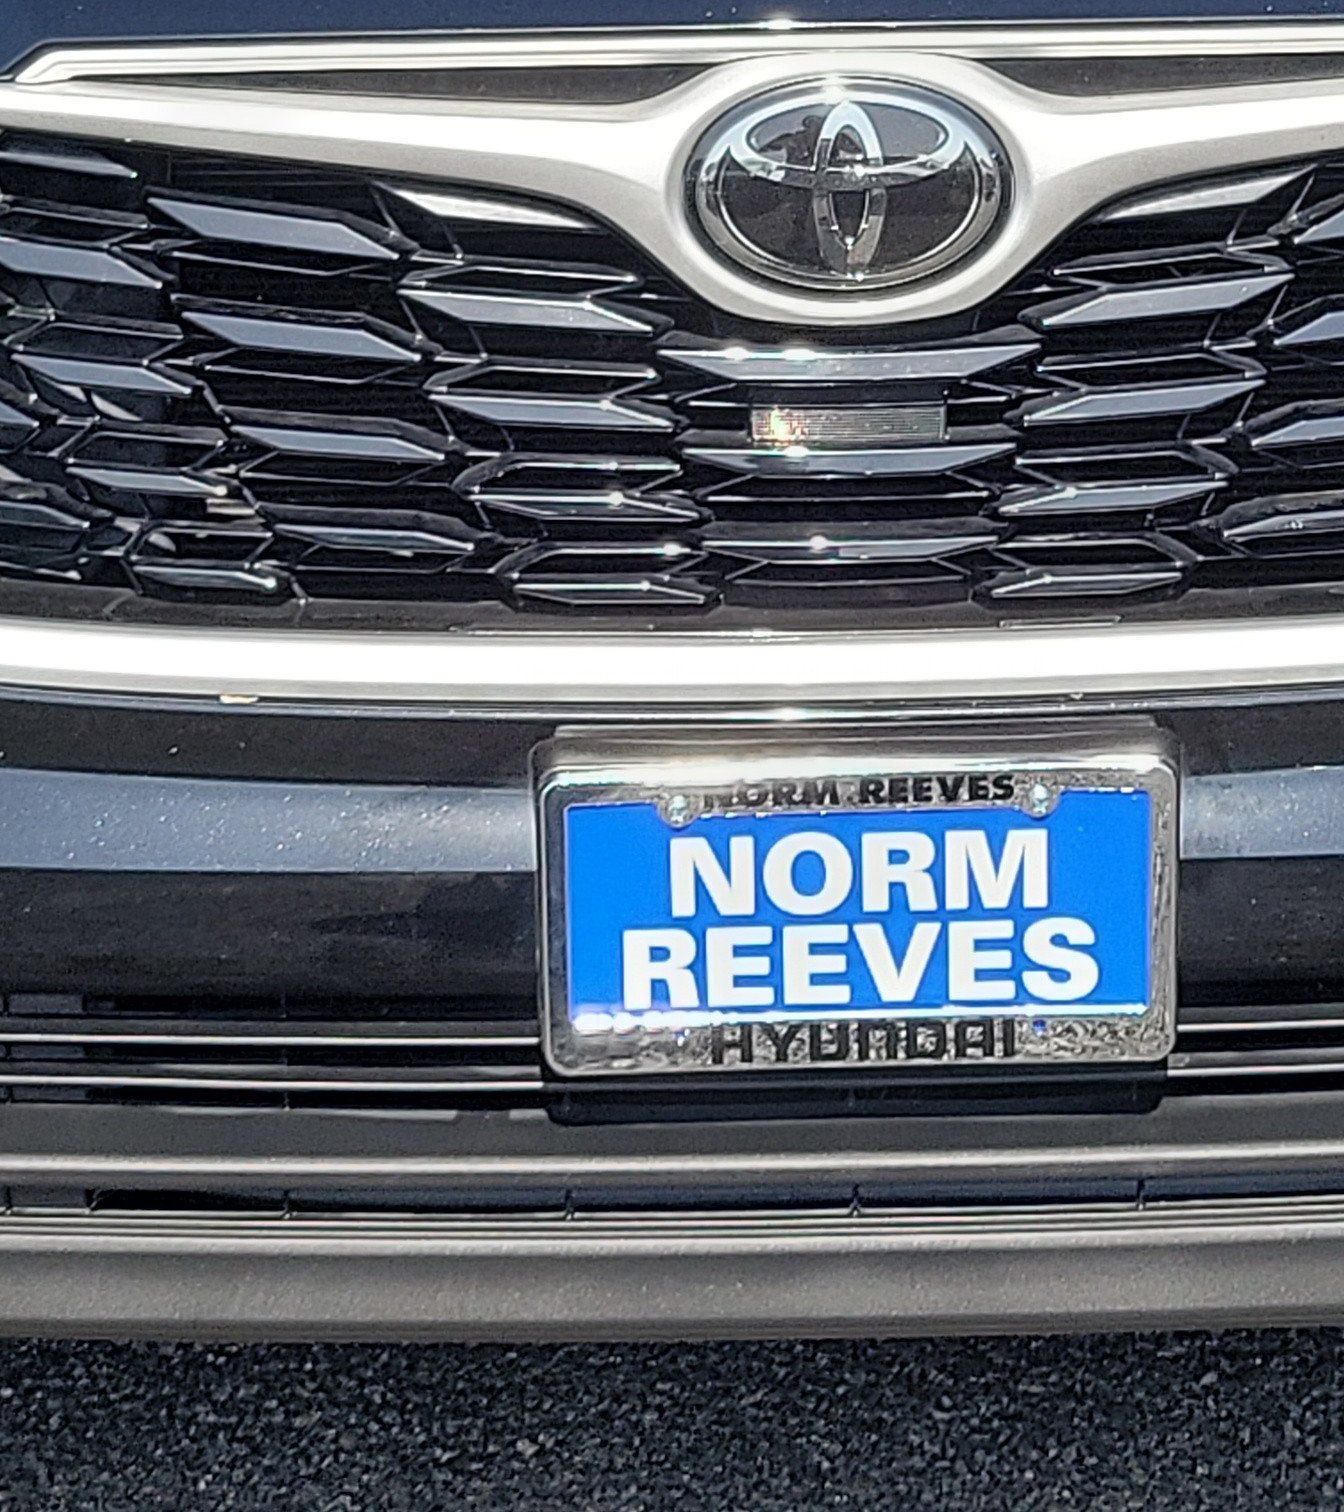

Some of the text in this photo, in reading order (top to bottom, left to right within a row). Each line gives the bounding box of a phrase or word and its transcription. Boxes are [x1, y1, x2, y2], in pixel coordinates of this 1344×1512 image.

[858, 774, 1015, 804] REEVES
[669, 828, 1049, 918] NORM
[622, 916, 1100, 1010] REEVES
[711, 1018, 1015, 1064] HYUNDAI
